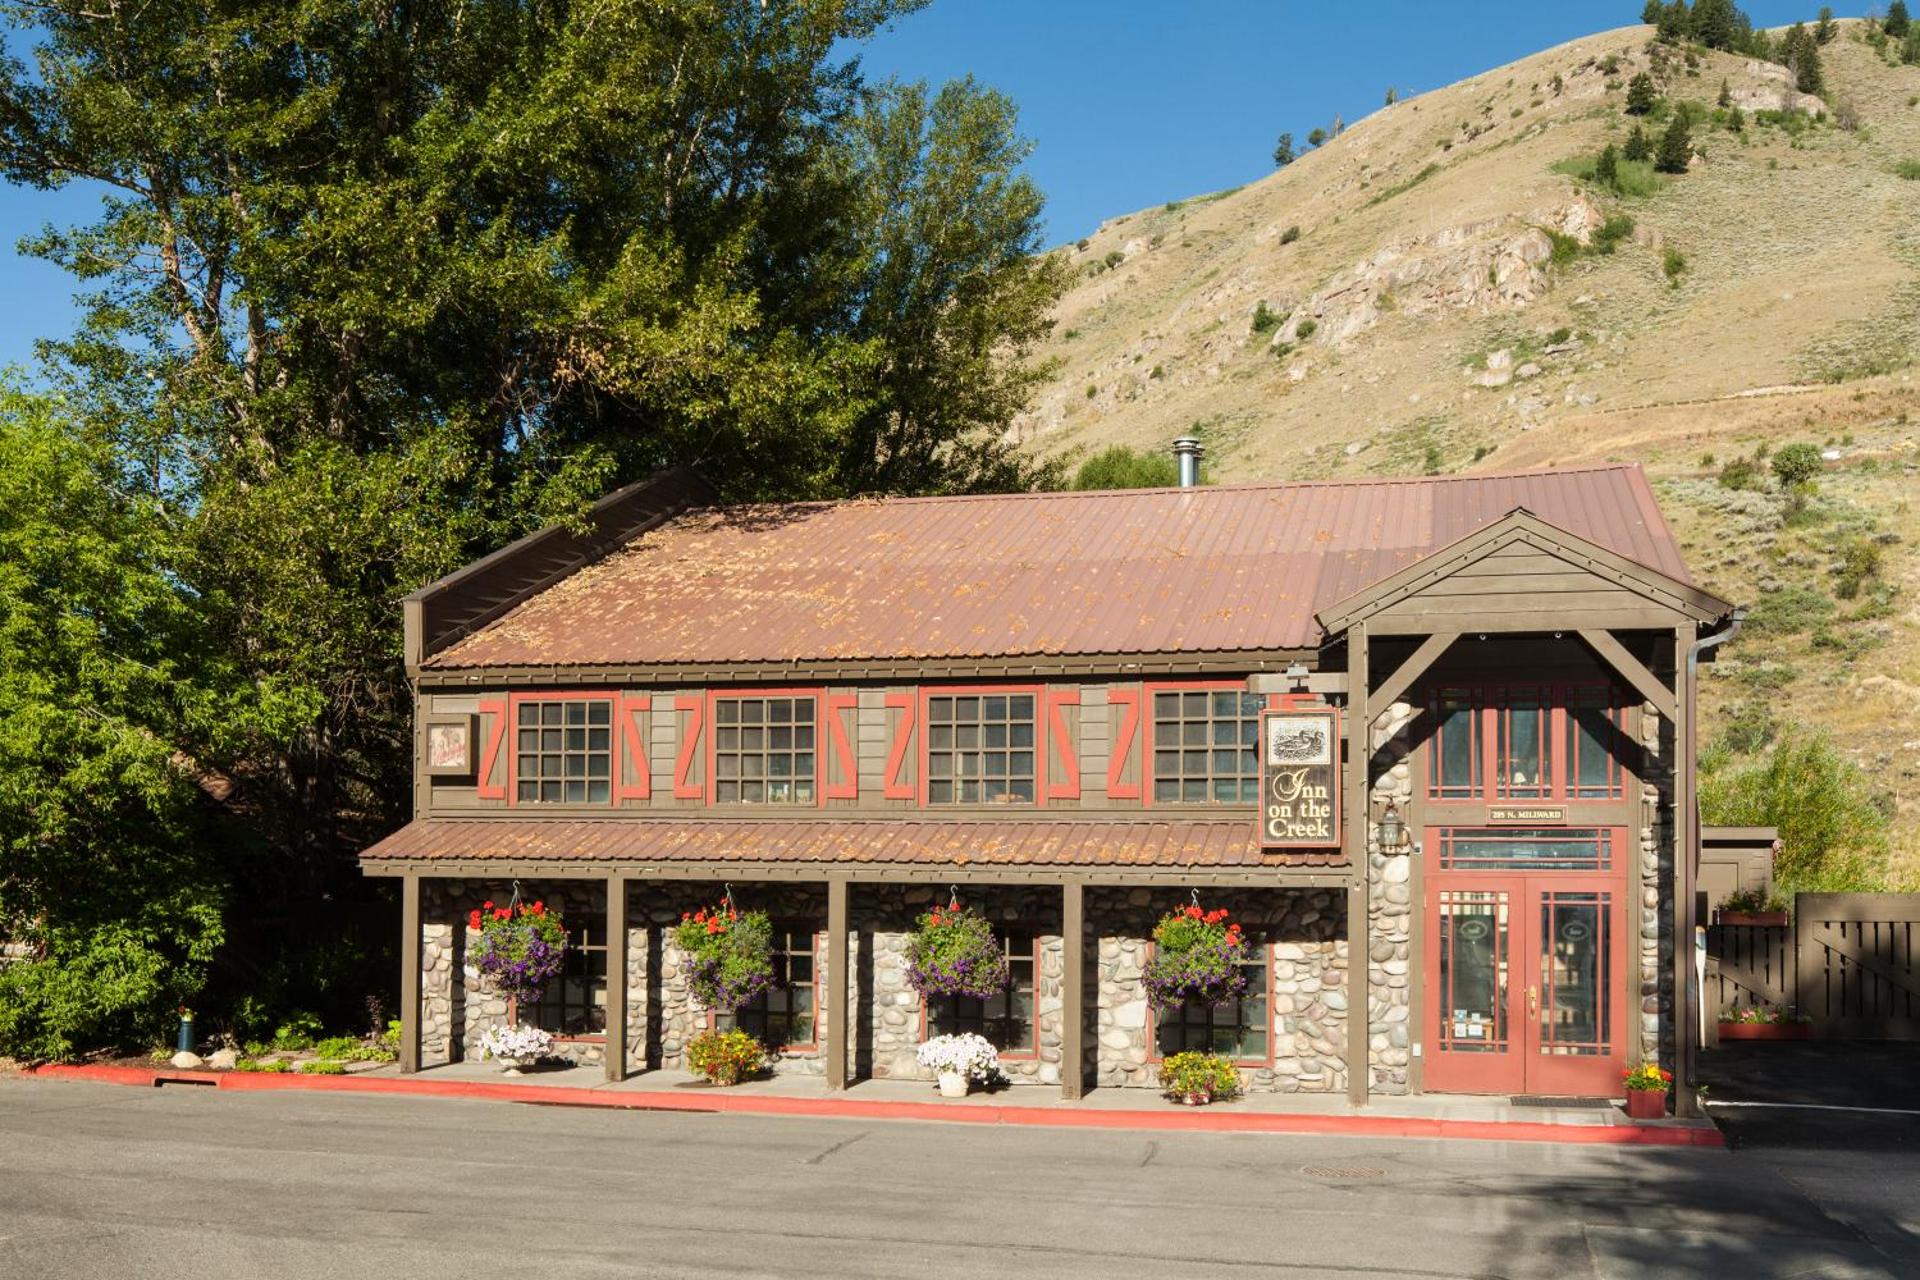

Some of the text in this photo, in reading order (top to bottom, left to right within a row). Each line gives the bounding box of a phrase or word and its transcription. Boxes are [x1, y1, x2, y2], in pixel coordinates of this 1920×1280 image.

[1273, 768, 1327, 801] Inn
[1269, 799, 1331, 818] on the
[1518, 811, 1561, 819] MILLWARD
[1269, 818, 1329, 837] Creek
